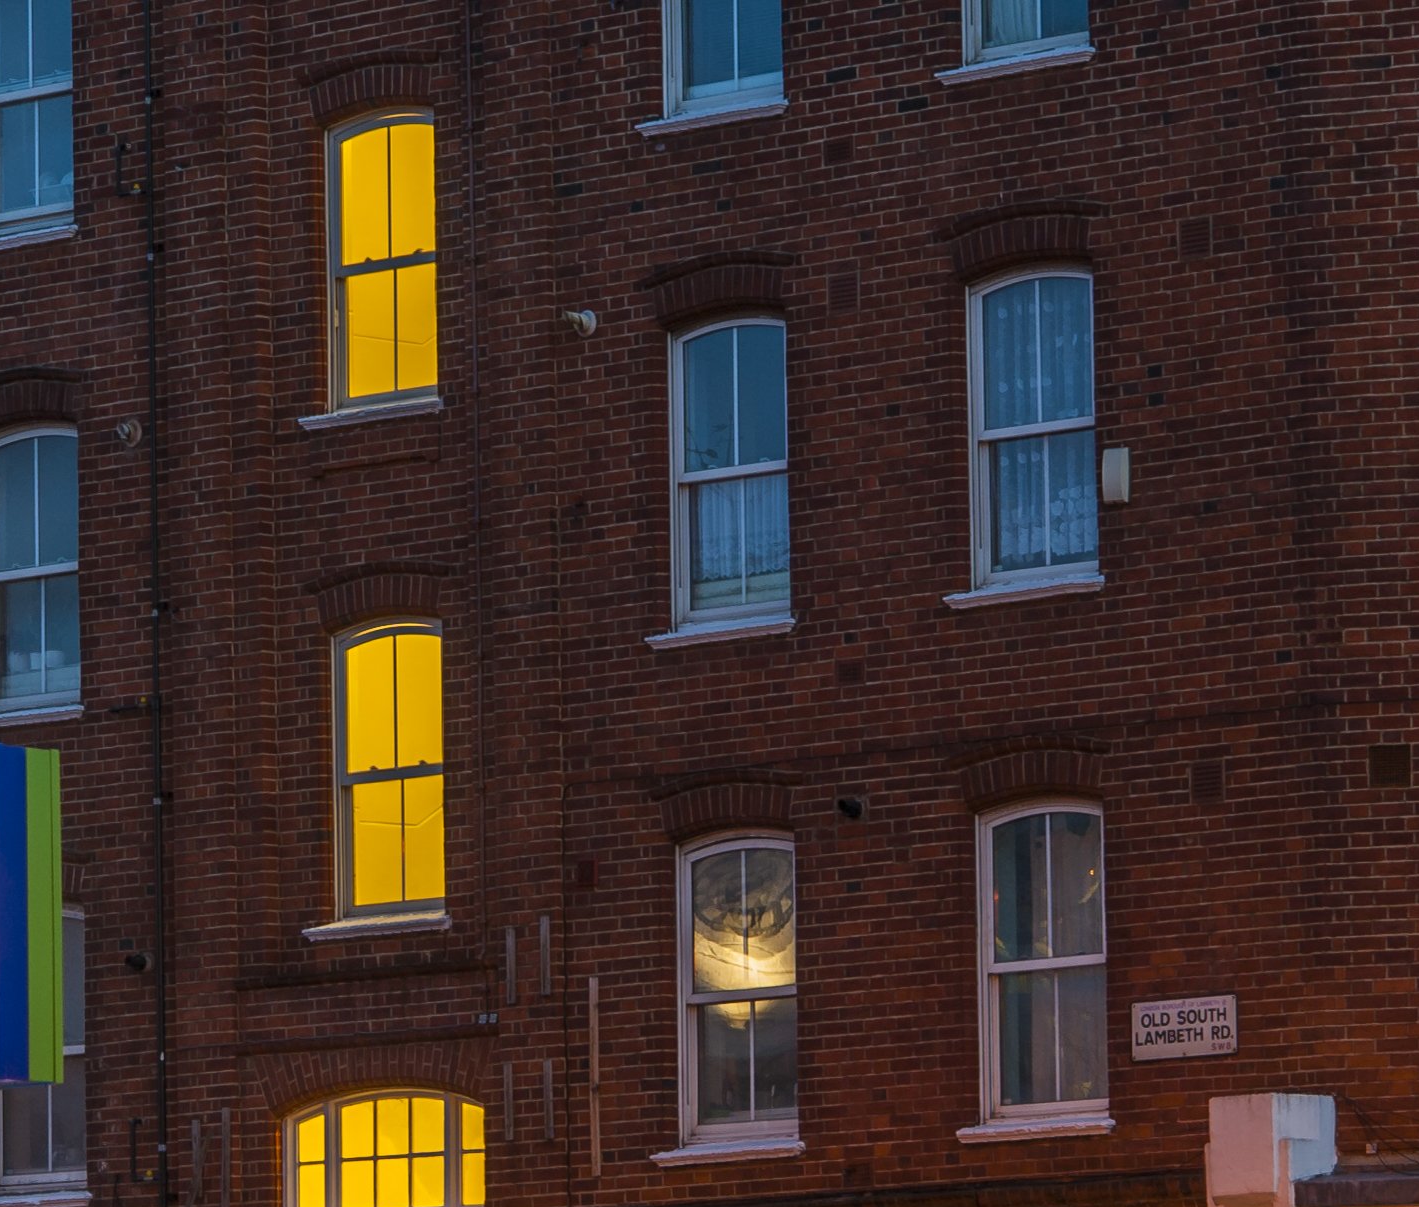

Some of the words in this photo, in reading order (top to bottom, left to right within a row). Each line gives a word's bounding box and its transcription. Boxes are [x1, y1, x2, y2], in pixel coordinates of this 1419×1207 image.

[1141, 1012, 1170, 1028] OLD
[1177, 1007, 1227, 1025] SOUTH
[1135, 1027, 1204, 1046] LAMBETH
